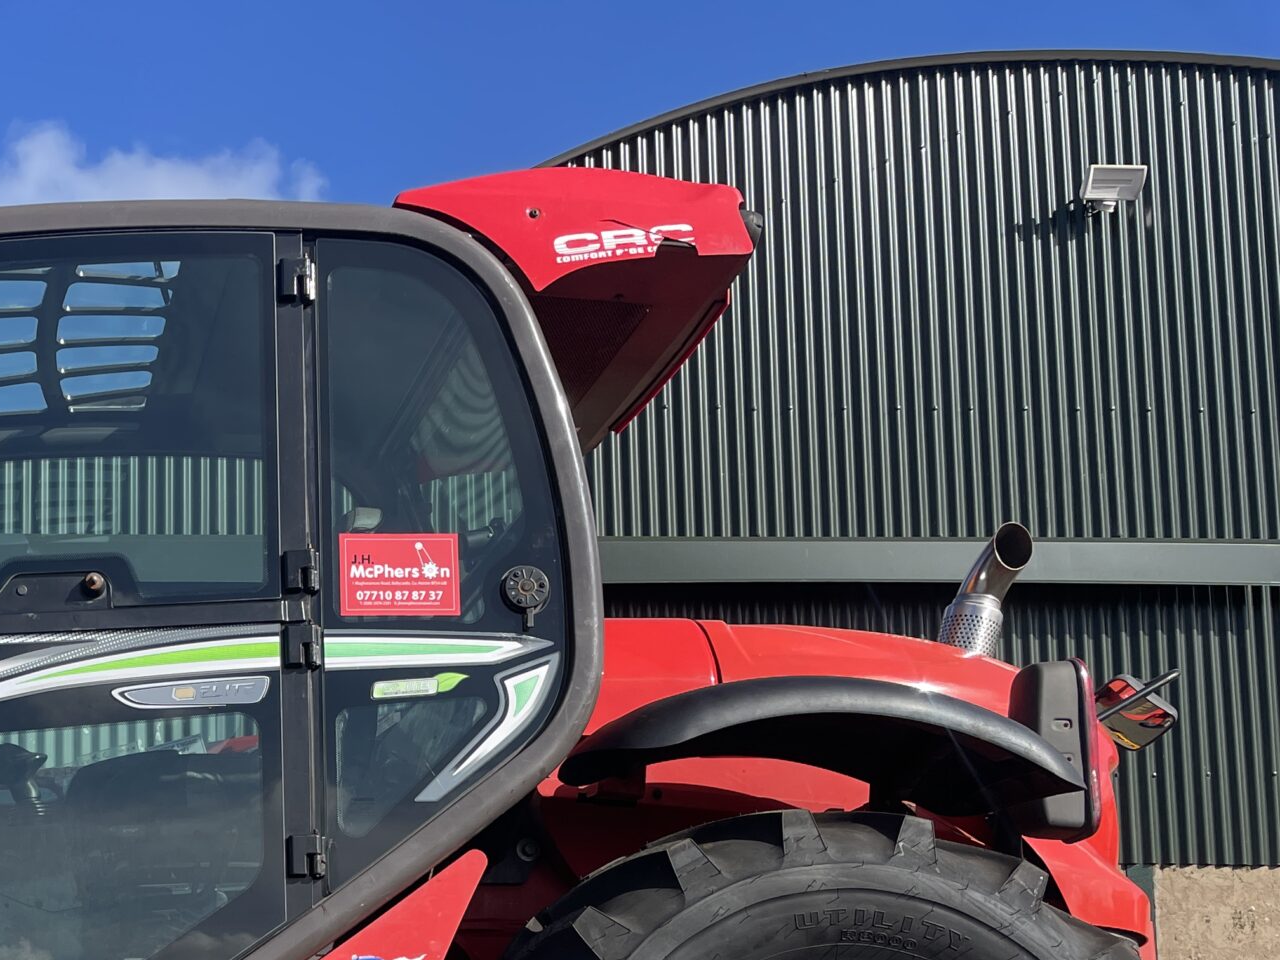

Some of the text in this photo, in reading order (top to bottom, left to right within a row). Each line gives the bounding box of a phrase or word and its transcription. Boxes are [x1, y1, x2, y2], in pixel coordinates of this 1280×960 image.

[556, 250, 613, 264] COMFORT
[351, 554, 375, 565] J.H.
[356, 590, 444, 601] 07710 87 87 37
[793, 908, 971, 951] UTILITY
